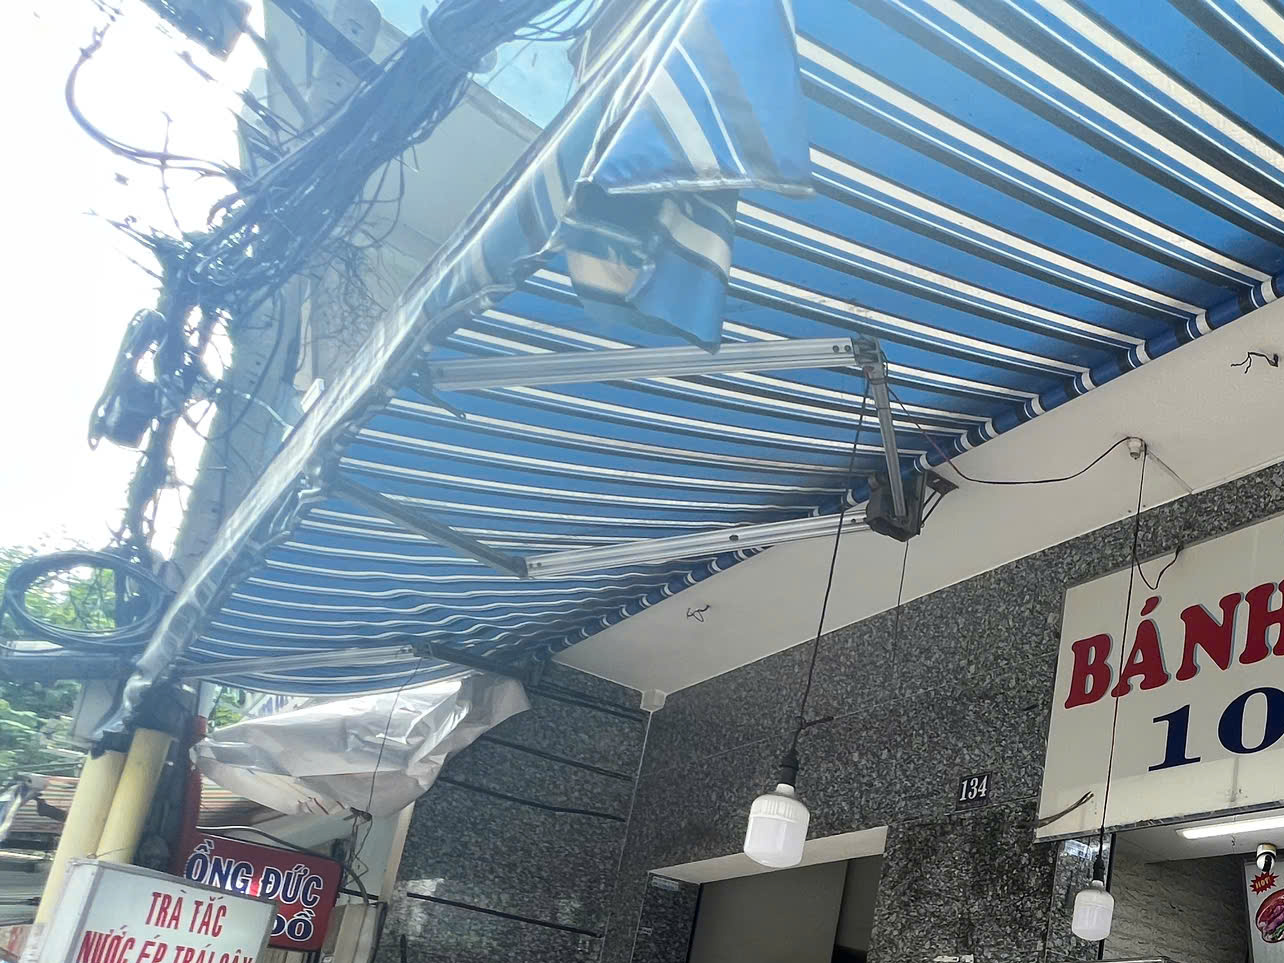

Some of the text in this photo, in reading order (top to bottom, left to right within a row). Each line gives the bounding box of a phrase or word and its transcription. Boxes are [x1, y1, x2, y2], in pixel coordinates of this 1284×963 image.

[960, 775, 987, 801] 134
[259, 864, 323, 908] ĐỨC
[145, 890, 227, 938] TRÀ TẮC
